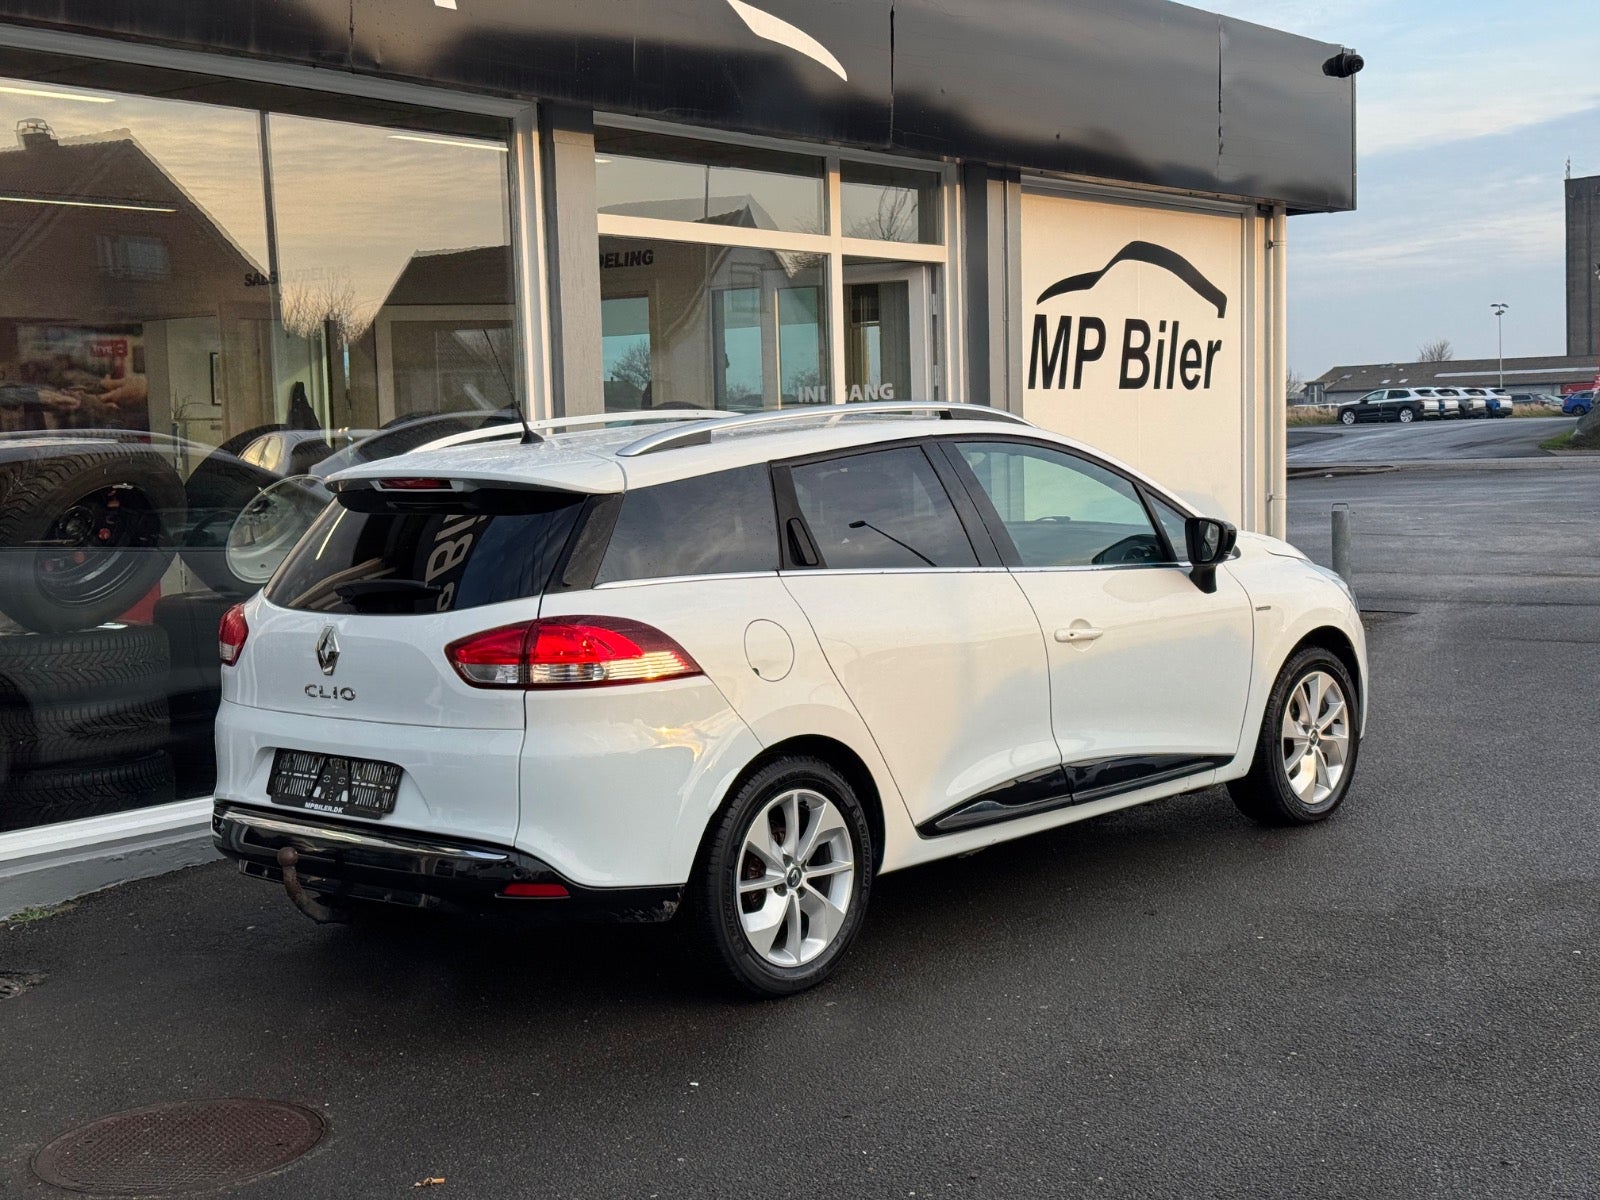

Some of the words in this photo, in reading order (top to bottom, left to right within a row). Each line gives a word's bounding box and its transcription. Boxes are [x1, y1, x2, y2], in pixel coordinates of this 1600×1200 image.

[1027, 313, 1107, 390] MP
[1118, 318, 1223, 391] Biler
[304, 684, 356, 701] CLIO
[304, 801, 344, 814] MPBILER.DK
